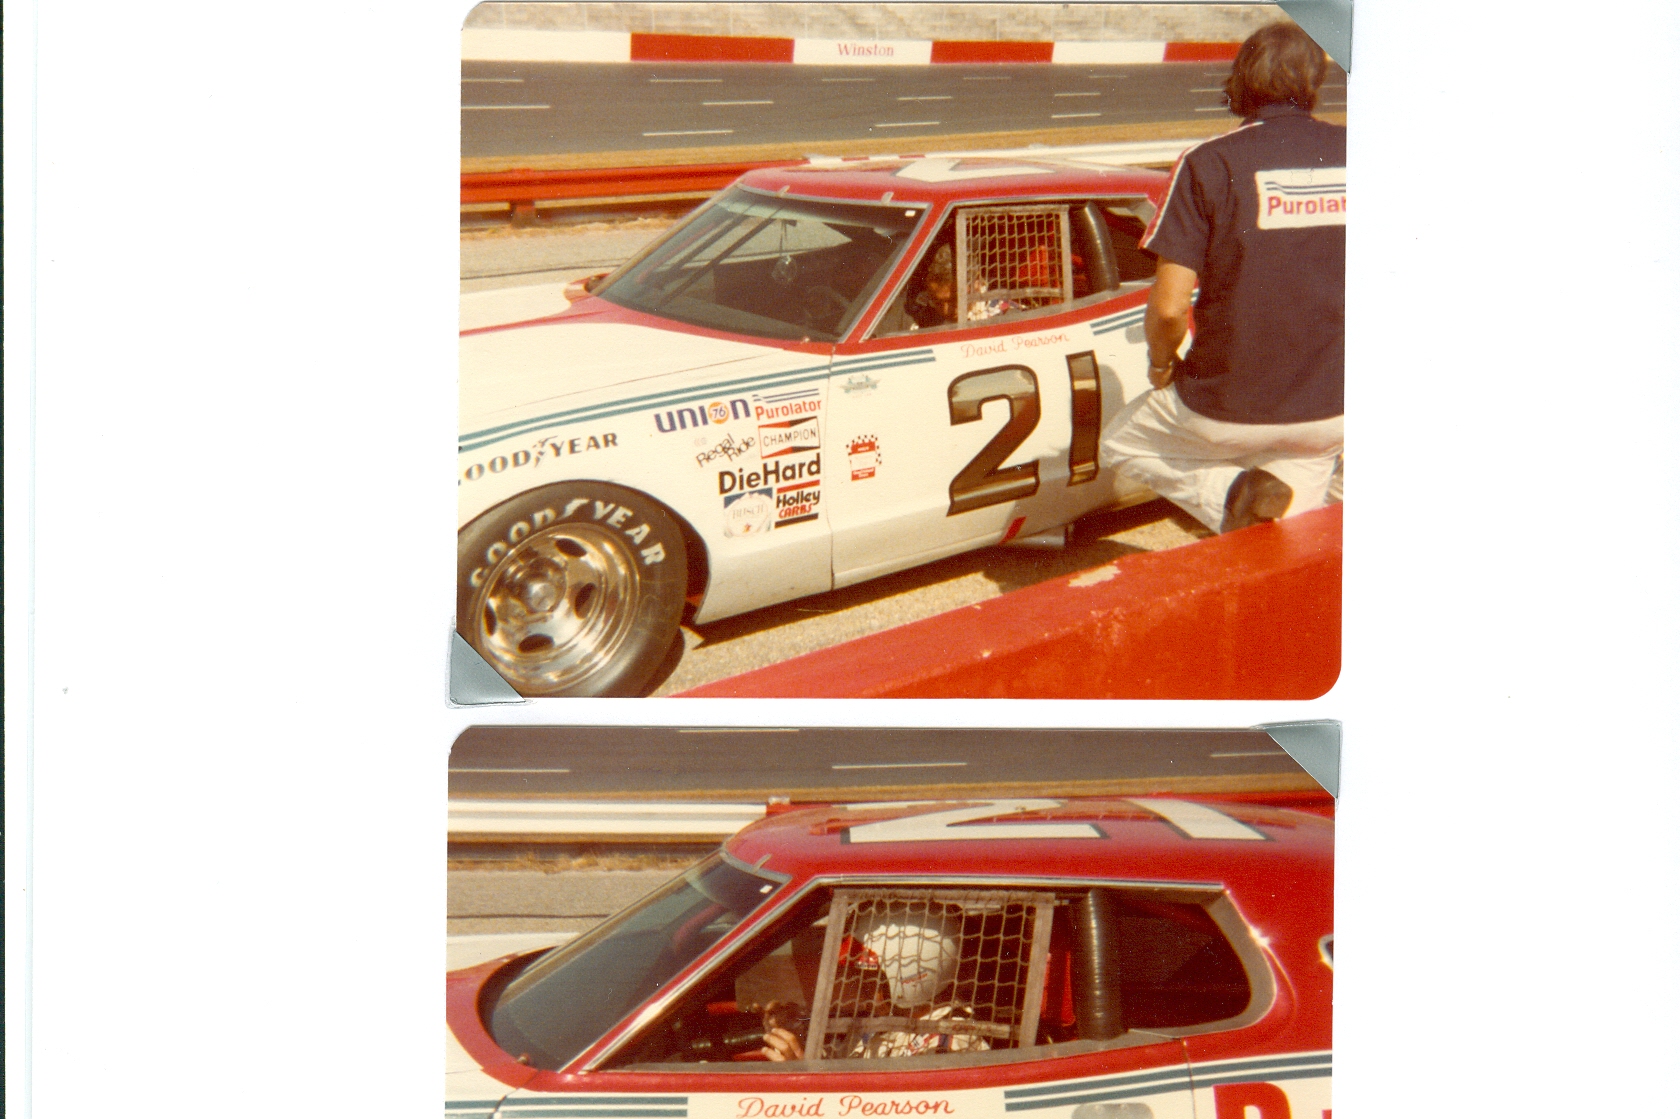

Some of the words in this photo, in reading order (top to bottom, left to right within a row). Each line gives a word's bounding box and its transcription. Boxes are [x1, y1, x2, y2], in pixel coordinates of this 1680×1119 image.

[838, 43, 894, 57] Winston
[960, 340, 1007, 358] David
[1011, 332, 1070, 349] Pearson
[754, 400, 822, 421] Purolator
[763, 427, 817, 447] CHAMPION
[946, 350, 1101, 518] 21
[458, 432, 619, 487] OODYEAR
[718, 452, 821, 496] DieHard
[776, 490, 821, 509] Holley
[778, 503, 813, 519] CARBS
[736, 1096, 825, 1119] David
[838, 1095, 954, 1117] Pearson
